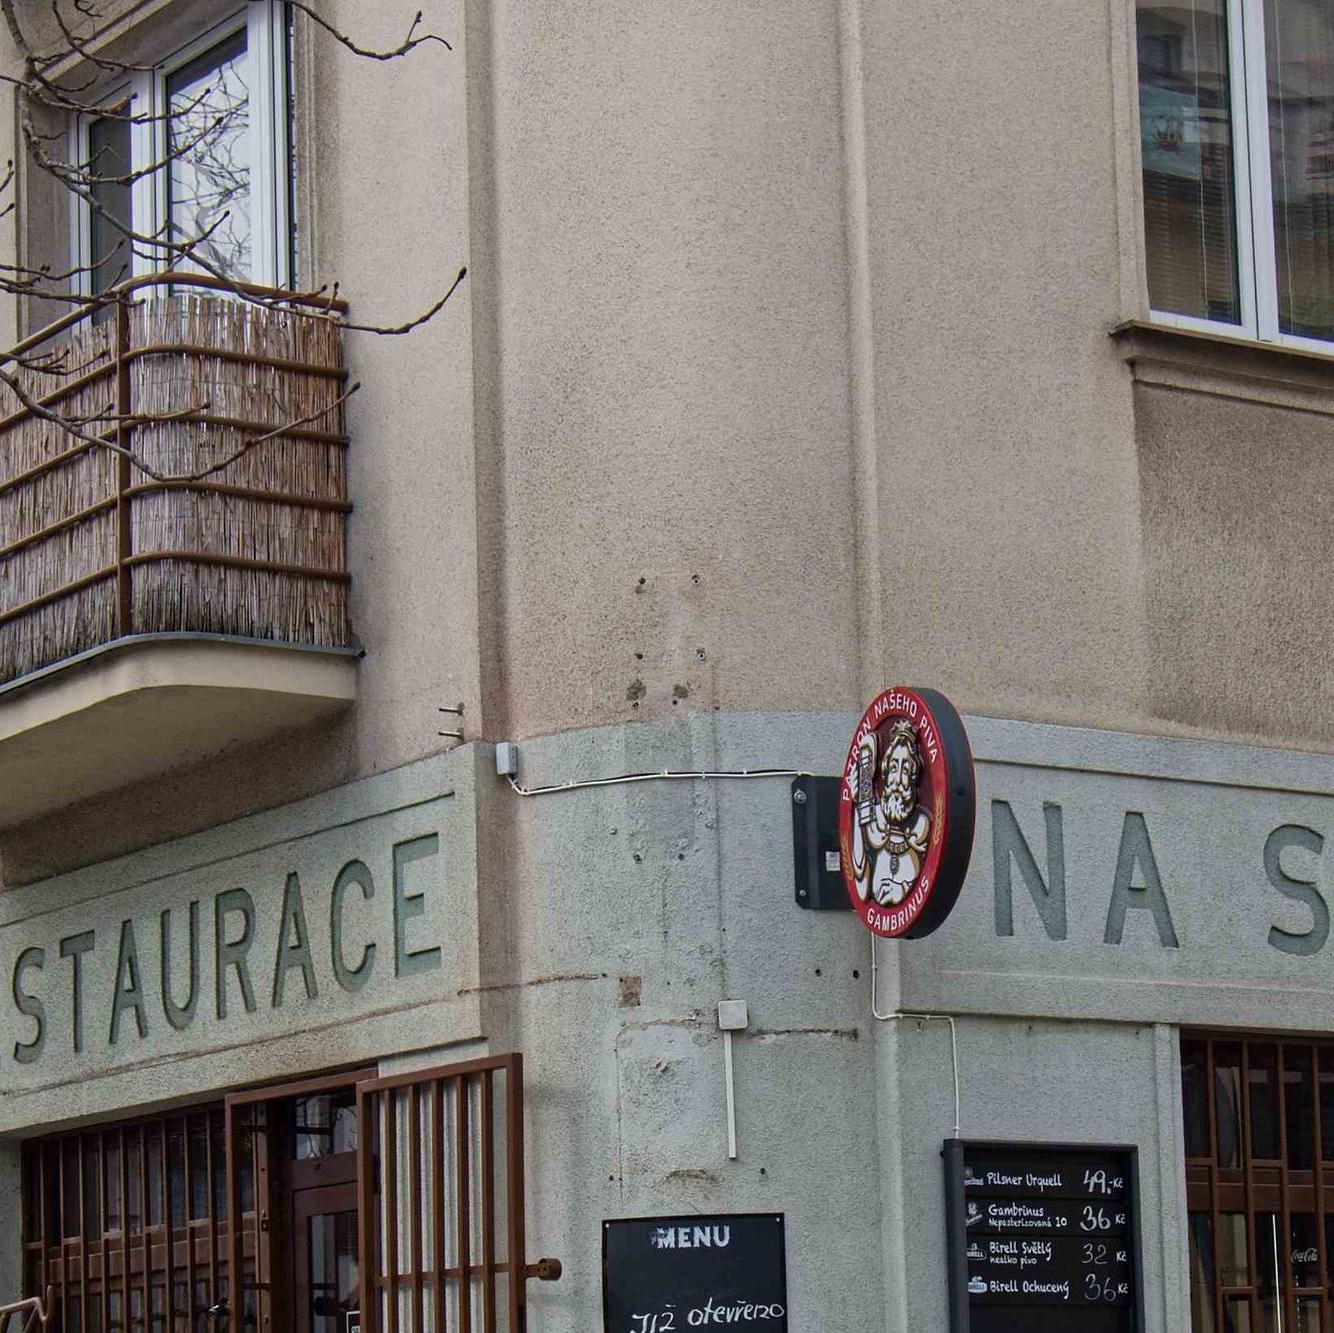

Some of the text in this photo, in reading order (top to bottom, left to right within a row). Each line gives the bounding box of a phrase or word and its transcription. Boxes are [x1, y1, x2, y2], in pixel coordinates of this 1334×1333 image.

[874, 689, 918, 719] NAŠEHO
[919, 715, 938, 764] PIVA
[990, 799, 1180, 949] NA
[866, 876, 930, 931] GAMBRINUS
[987, 1172, 1023, 1186] Pilsner
[1026, 1173, 1063, 1193] Urquell
[988, 1202, 1045, 1217] Gambrinus
[1080, 1205, 1126, 1231] 36 Kč
[1055, 1216, 1068, 1227] 10
[653, 1225, 731, 1248] MENU
[989, 1241, 1052, 1261] Birell Světlý
[1082, 1242, 1127, 1265] 32 Kč
[989, 1280, 1018, 1293] Birell
[1022, 1280, 1070, 1300] Ochucený
[1084, 1273, 1117, 1302] 36
[1117, 1282, 1129, 1294] Kč
